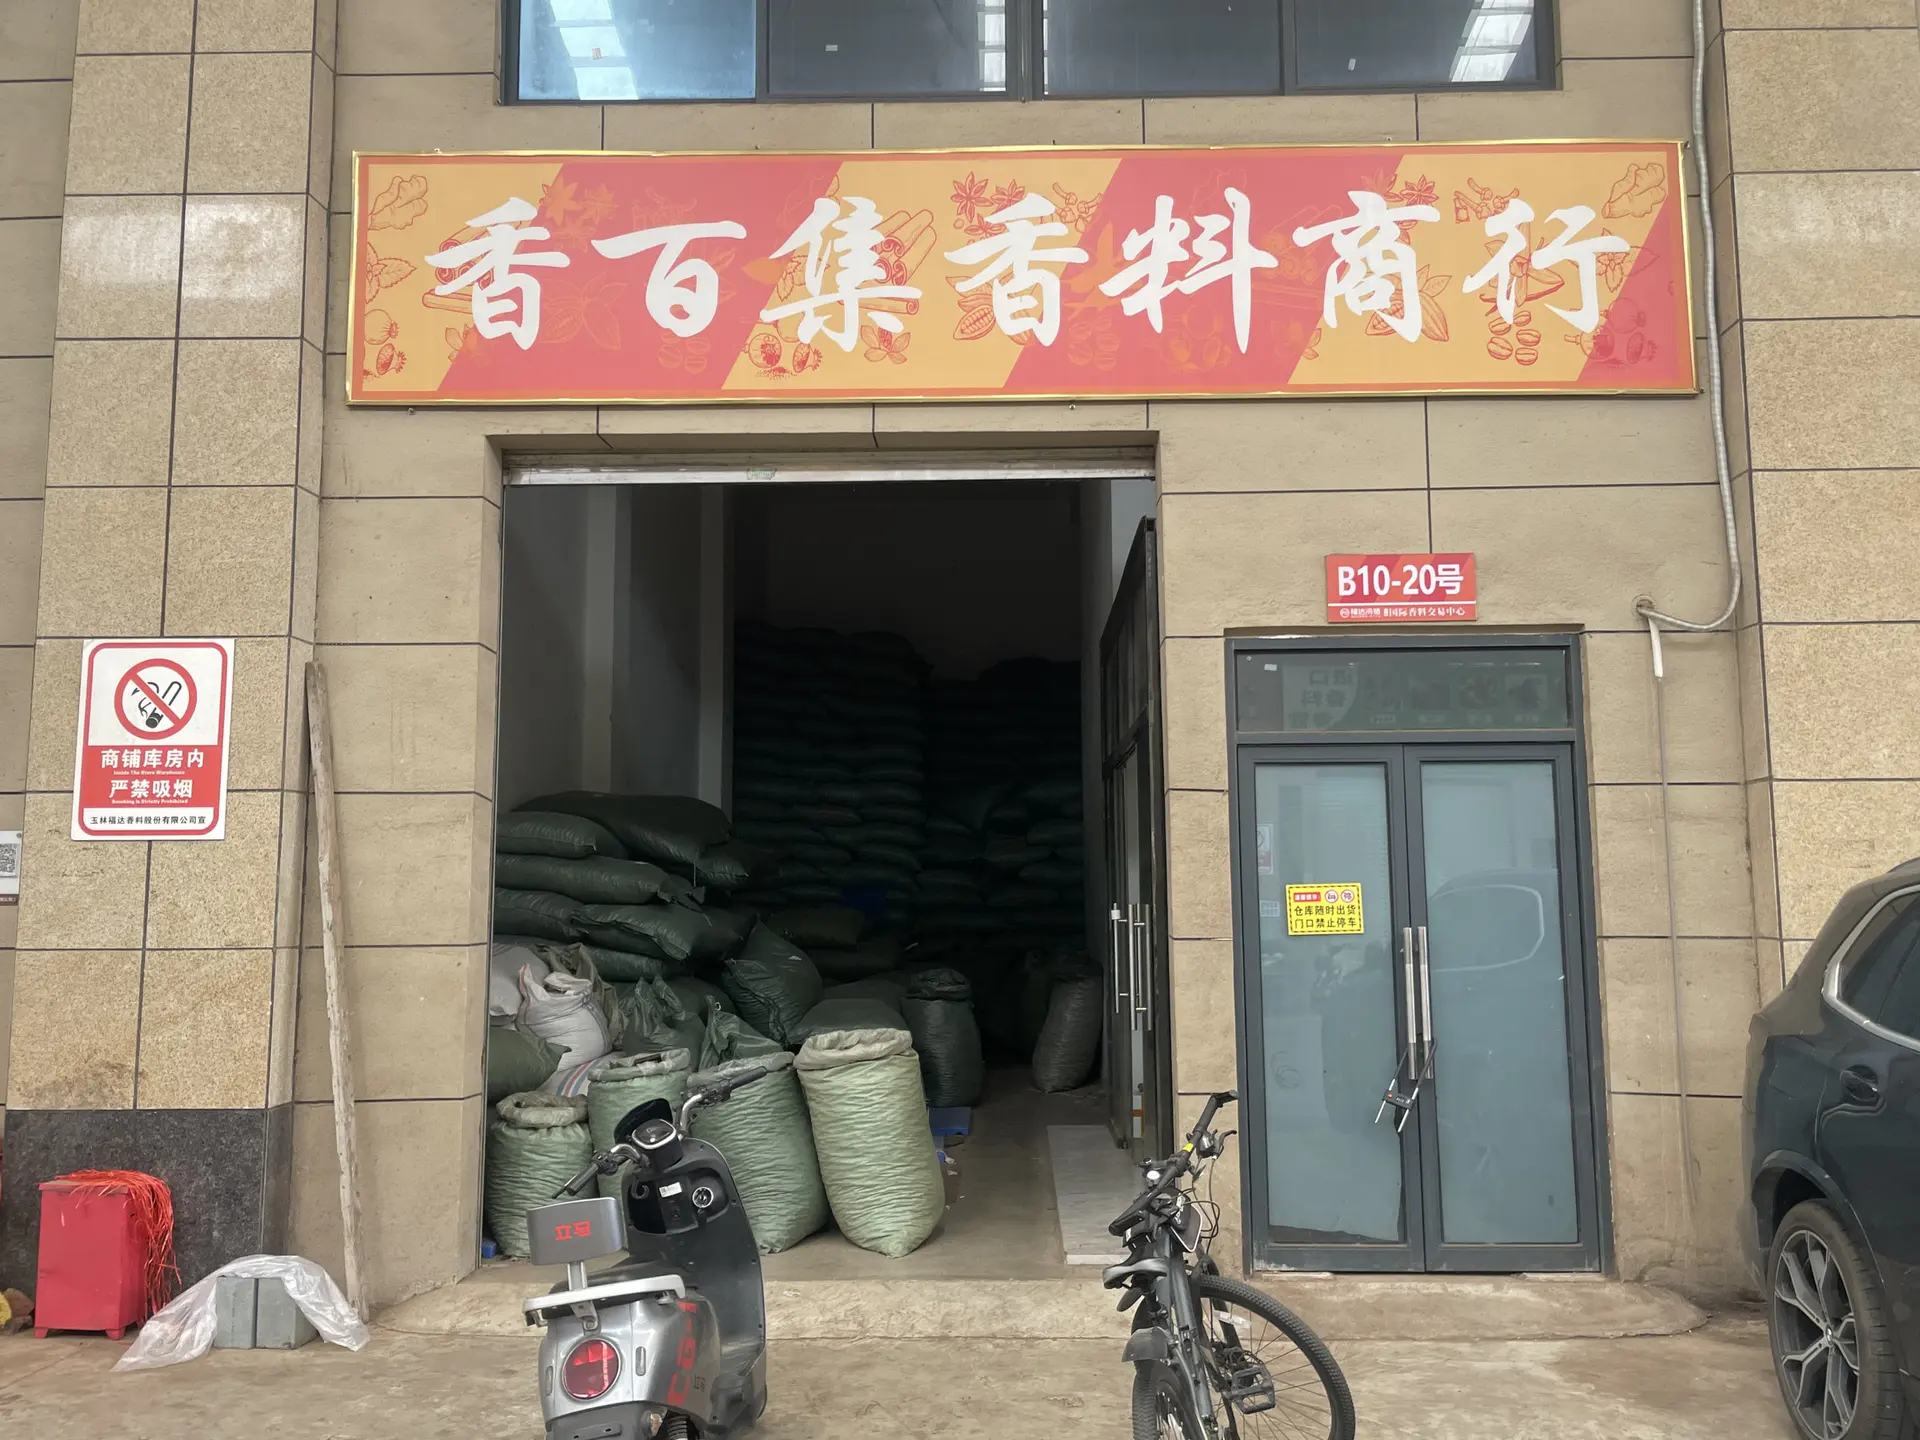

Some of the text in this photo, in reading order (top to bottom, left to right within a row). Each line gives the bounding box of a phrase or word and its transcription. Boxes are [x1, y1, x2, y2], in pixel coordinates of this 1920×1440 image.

[425, 187, 1630, 354] 香百集香料商行
[1338, 563, 1464, 596] B10-20号
[101, 748, 204, 768] 商铺库房内
[109, 779, 193, 798] 严禁吸烟
[90, 815, 206, 824] 玉林福达香料股份有限公司宣
[1294, 905, 1356, 916] 仓库随时出货
[1295, 917, 1357, 929] 门口禁止停车
